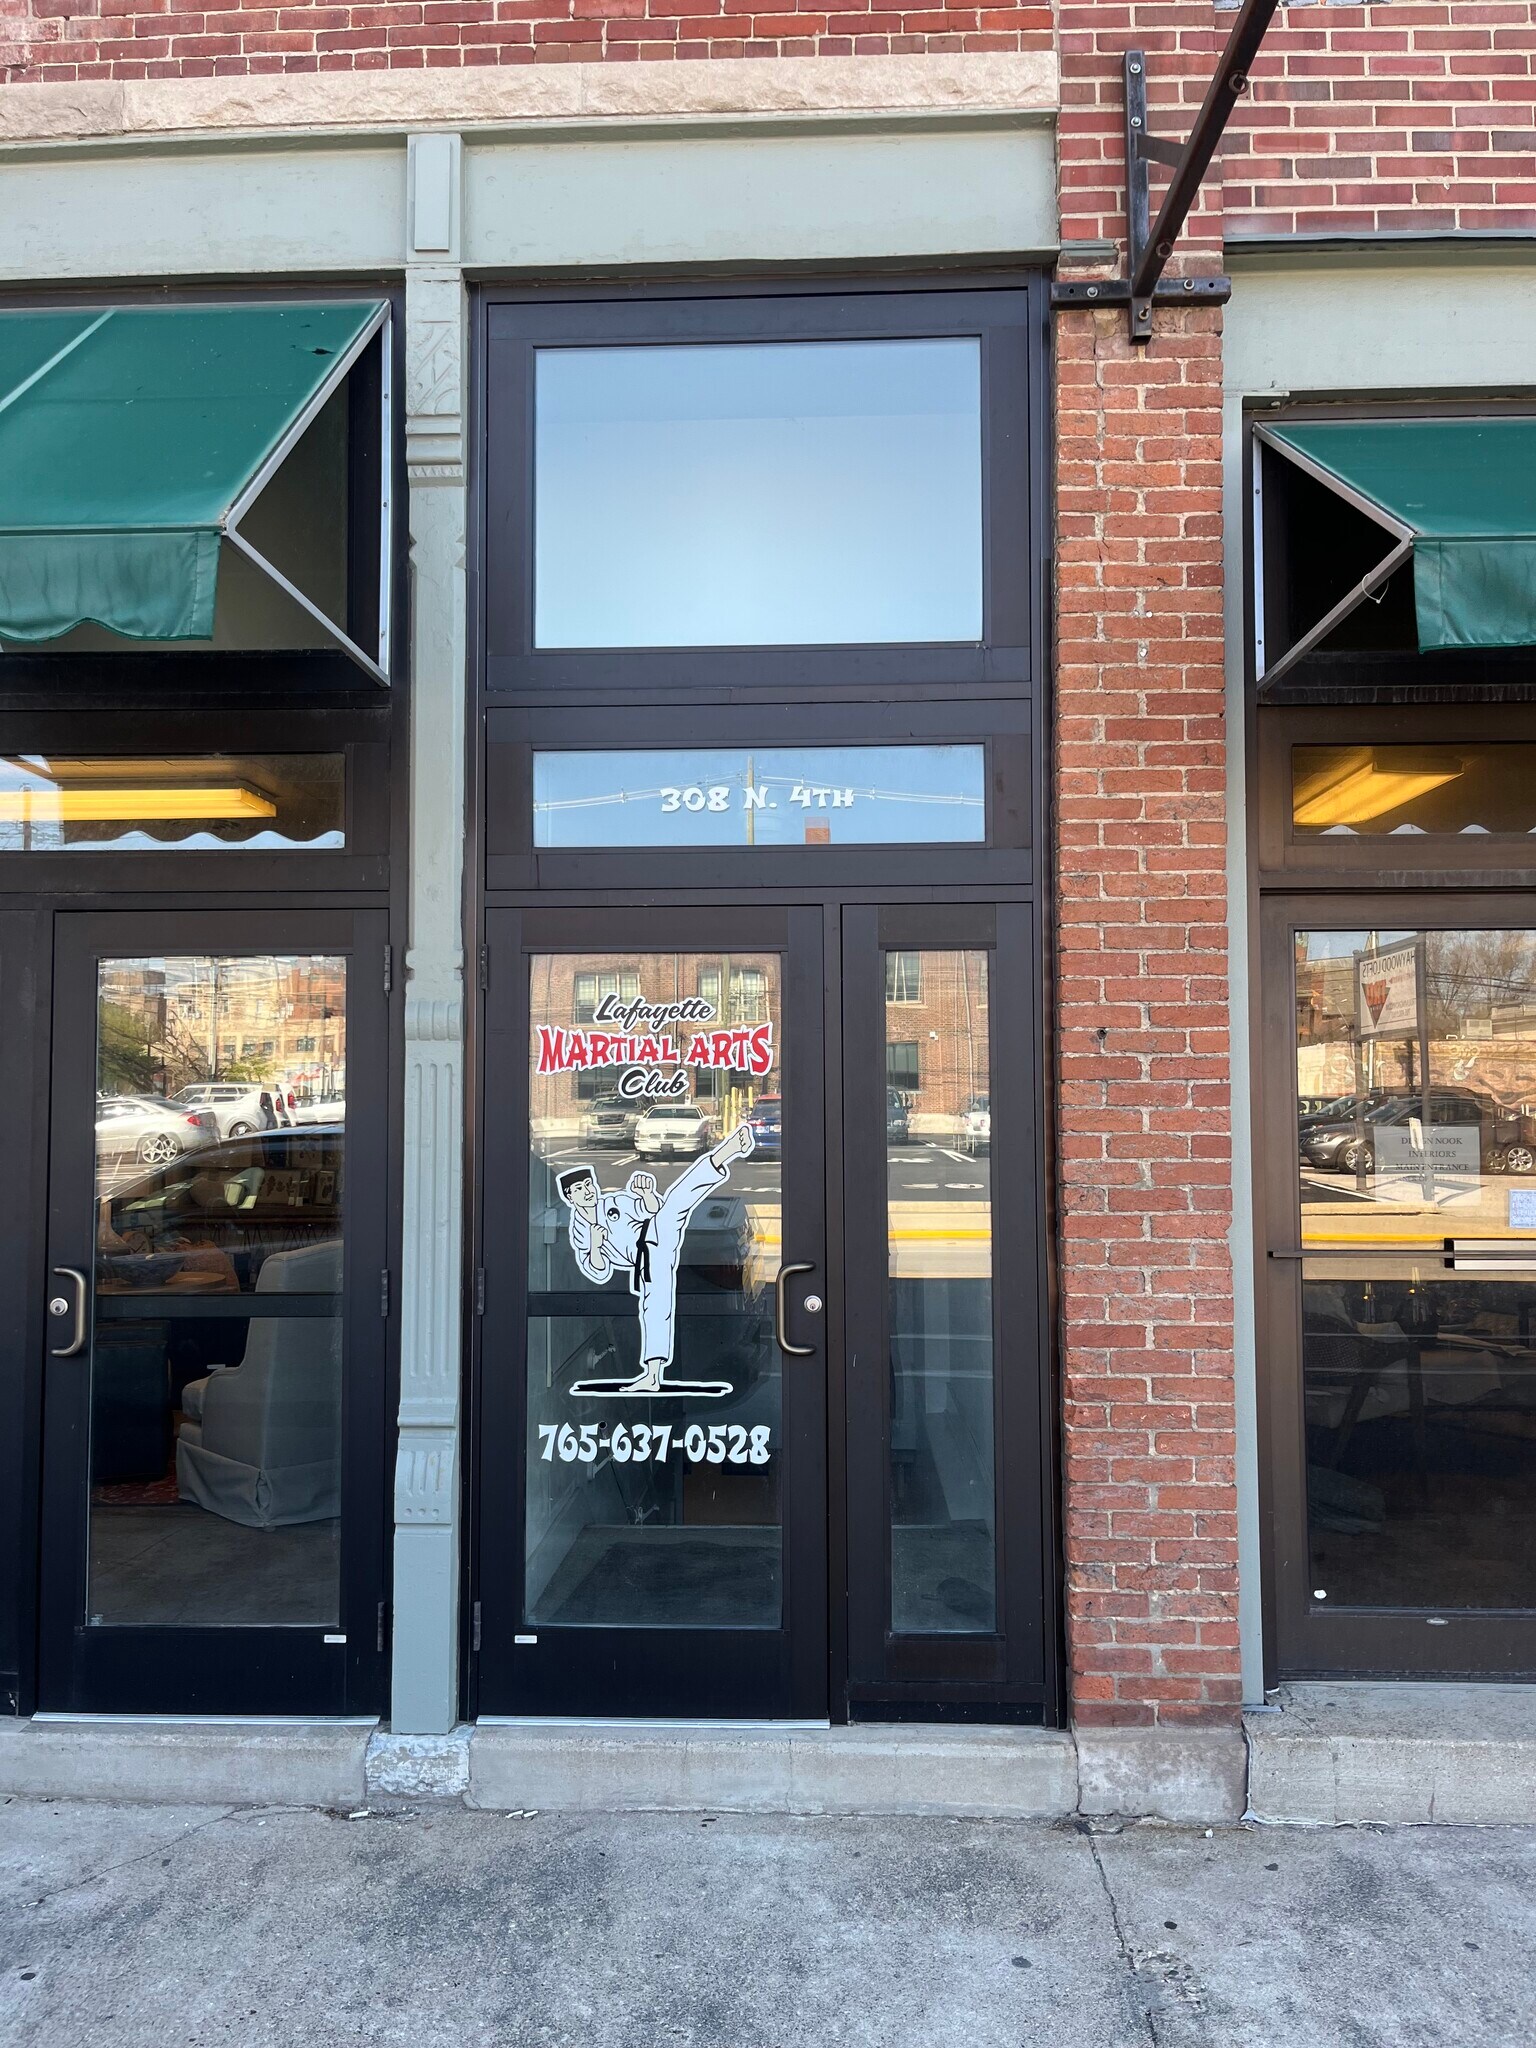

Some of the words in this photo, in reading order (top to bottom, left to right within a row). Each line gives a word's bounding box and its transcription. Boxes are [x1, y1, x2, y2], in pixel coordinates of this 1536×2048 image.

[660, 785, 730, 812] 308
[743, 784, 777, 809] N.
[789, 785, 854, 808] 4TH
[594, 993, 715, 1031] Lafayette
[538, 1027, 680, 1073] MARTIAL
[686, 1022, 773, 1075] ARTS
[620, 1069, 687, 1097] Club
[1408, 1150, 1457, 1158] INTERIORS
[1435, 1137, 1463, 1145] NOOK
[1395, 1163, 1420, 1171] MAIN
[1421, 1163, 1469, 1171] ENTRANCE
[538, 1422, 772, 1464] 765-637-0528
